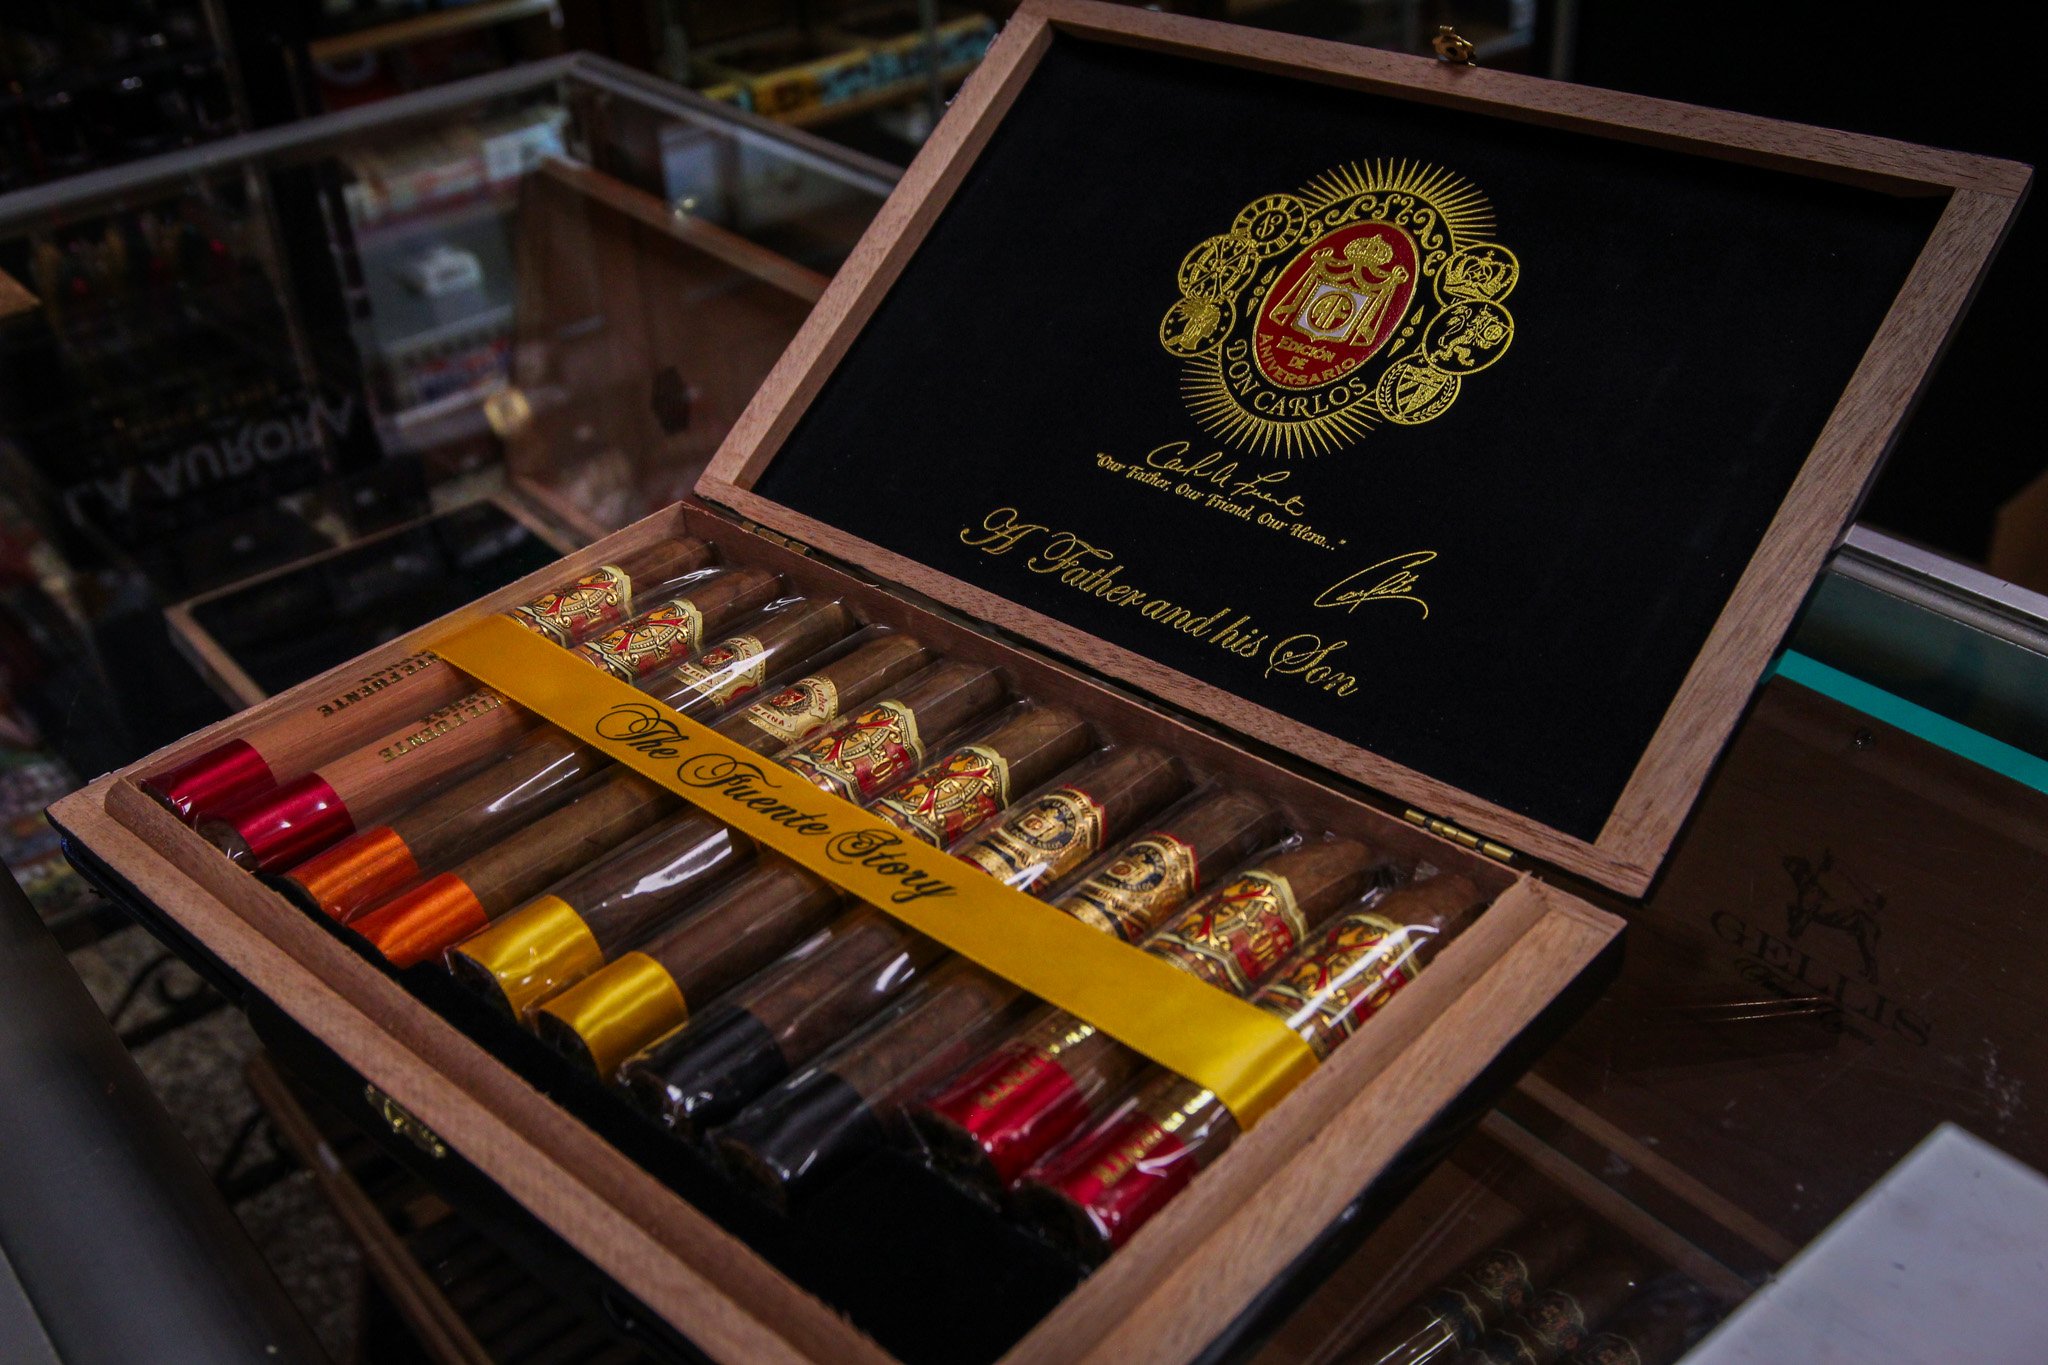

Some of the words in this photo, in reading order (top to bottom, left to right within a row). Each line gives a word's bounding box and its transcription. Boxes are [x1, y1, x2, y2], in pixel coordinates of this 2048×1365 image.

[1226, 340, 1259, 396] DON
[1253, 377, 1367, 418] CARLOS
[1259, 333, 1357, 386] ANIVERSARIO
[1276, 335, 1336, 363] EDICIÓN
[1287, 356, 1309, 370] DE
[1127, 464, 1171, 492] Father,
[1175, 482, 1204, 500] Our
[1205, 493, 1252, 522] Friend,
[1258, 512, 1289, 531] Our
[1028, 531, 1143, 607] Father
[1141, 599, 1231, 641] and
[1208, 608, 1269, 658] his
[1264, 634, 1358, 697] Son
[317, 664, 403, 718] FUENTE
[378, 714, 468, 763] FUENTE
[595, 703, 689, 759] The
[677, 753, 831, 837] Fuente
[825, 828, 957, 904] Story
[1711, 909, 1932, 1046] GELLIS
